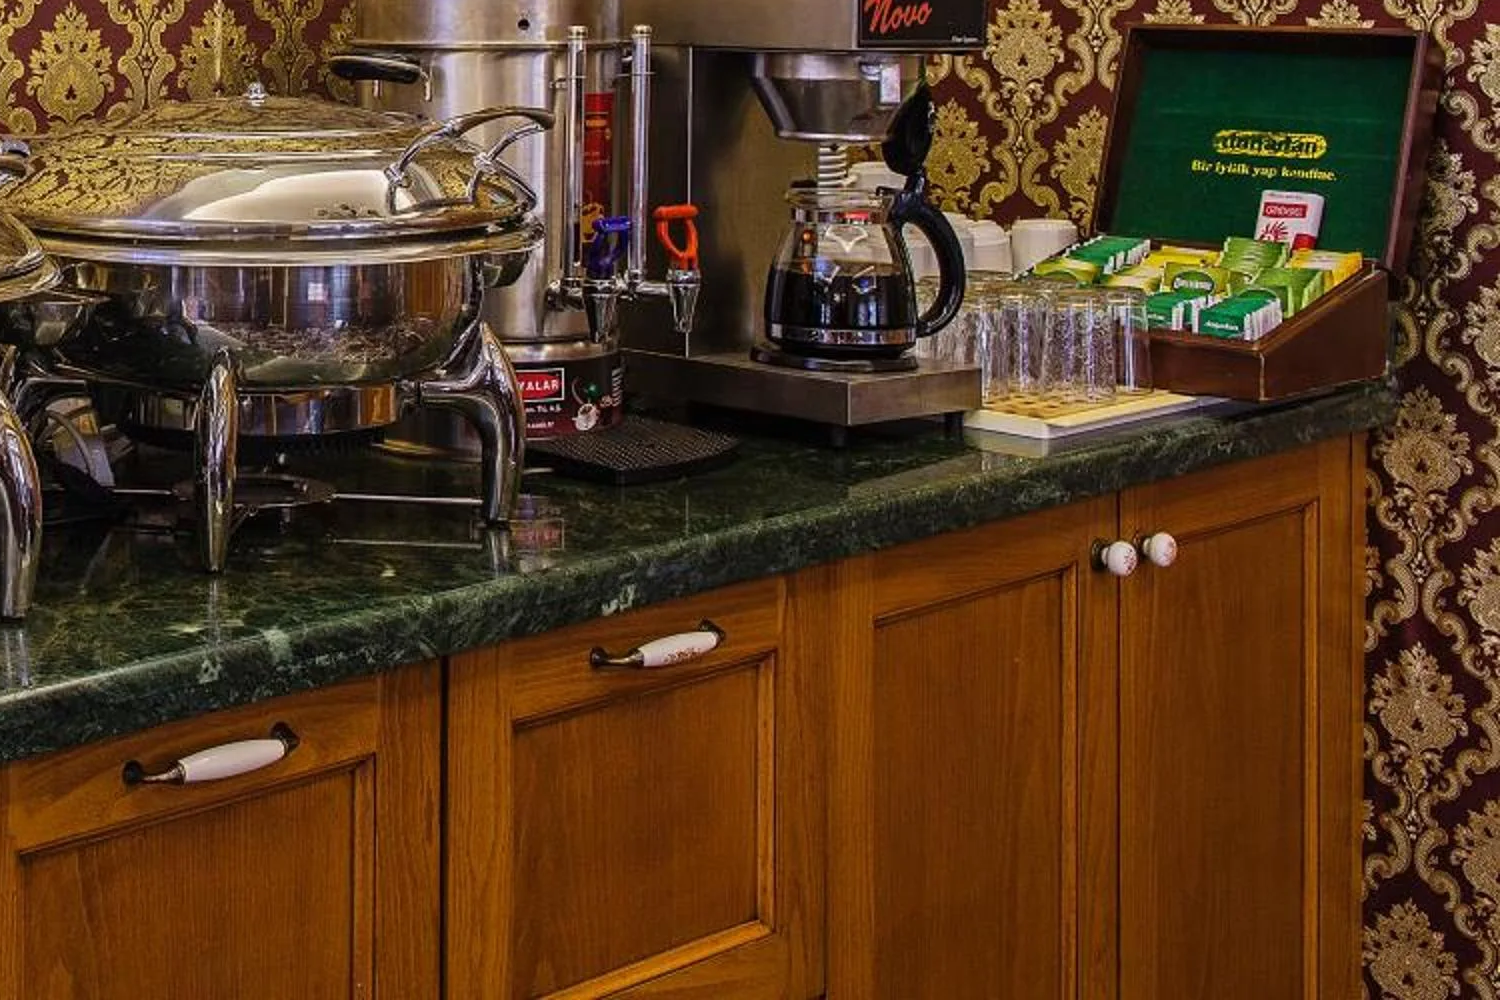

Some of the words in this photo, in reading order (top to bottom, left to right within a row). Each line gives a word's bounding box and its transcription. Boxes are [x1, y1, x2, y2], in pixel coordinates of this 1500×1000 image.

[1191, 159, 1213, 172] Bir
[1252, 166, 1277, 179] yap
[517, 379, 560, 392] YALAR
